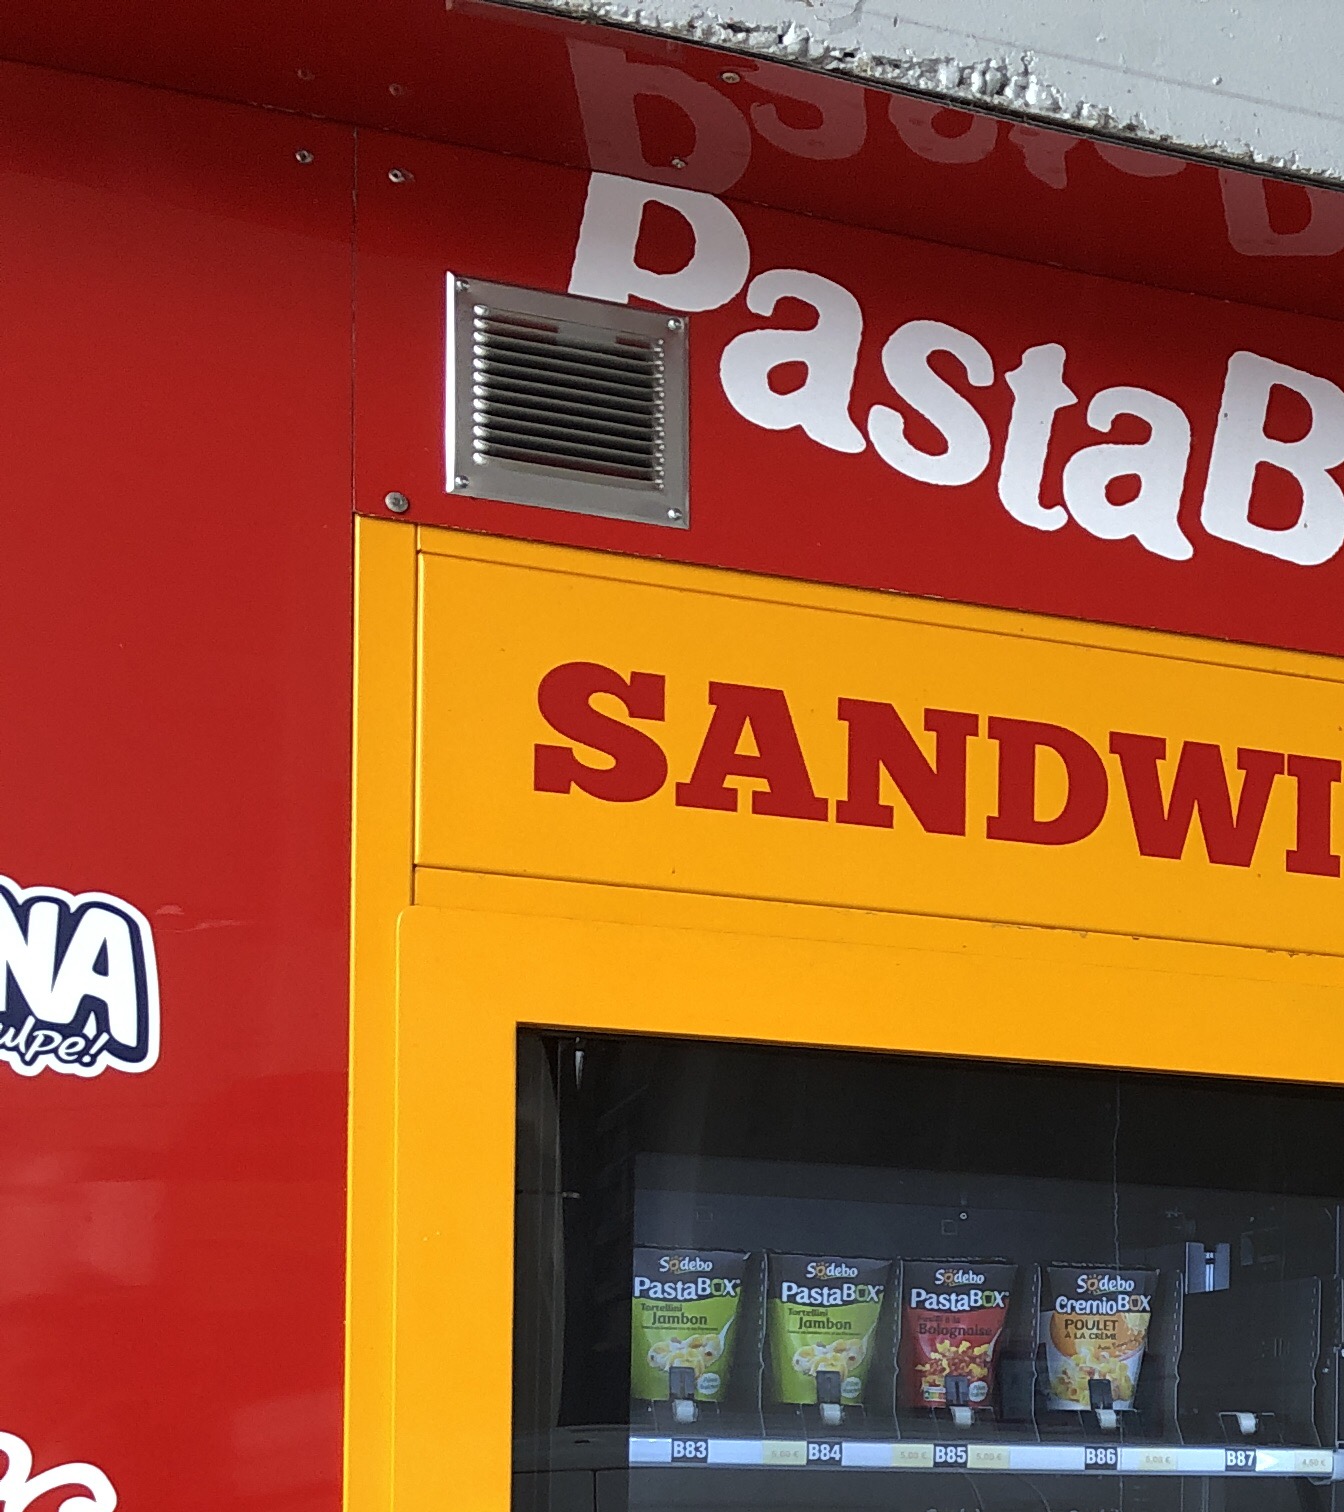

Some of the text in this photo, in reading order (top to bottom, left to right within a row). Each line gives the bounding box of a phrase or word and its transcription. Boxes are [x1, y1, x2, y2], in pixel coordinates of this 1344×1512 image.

[652, 1313, 708, 1327] Jambon
[798, 1317, 852, 1330] Jambon
[1064, 1317, 1119, 1332] POULET
[918, 1322, 993, 1338] Bolognaise
[673, 1441, 707, 1458] B83
[808, 1443, 841, 1460] B84
[935, 1446, 967, 1463] B85
[1086, 1448, 1117, 1466] B86
[1226, 1450, 1255, 1467] B87
